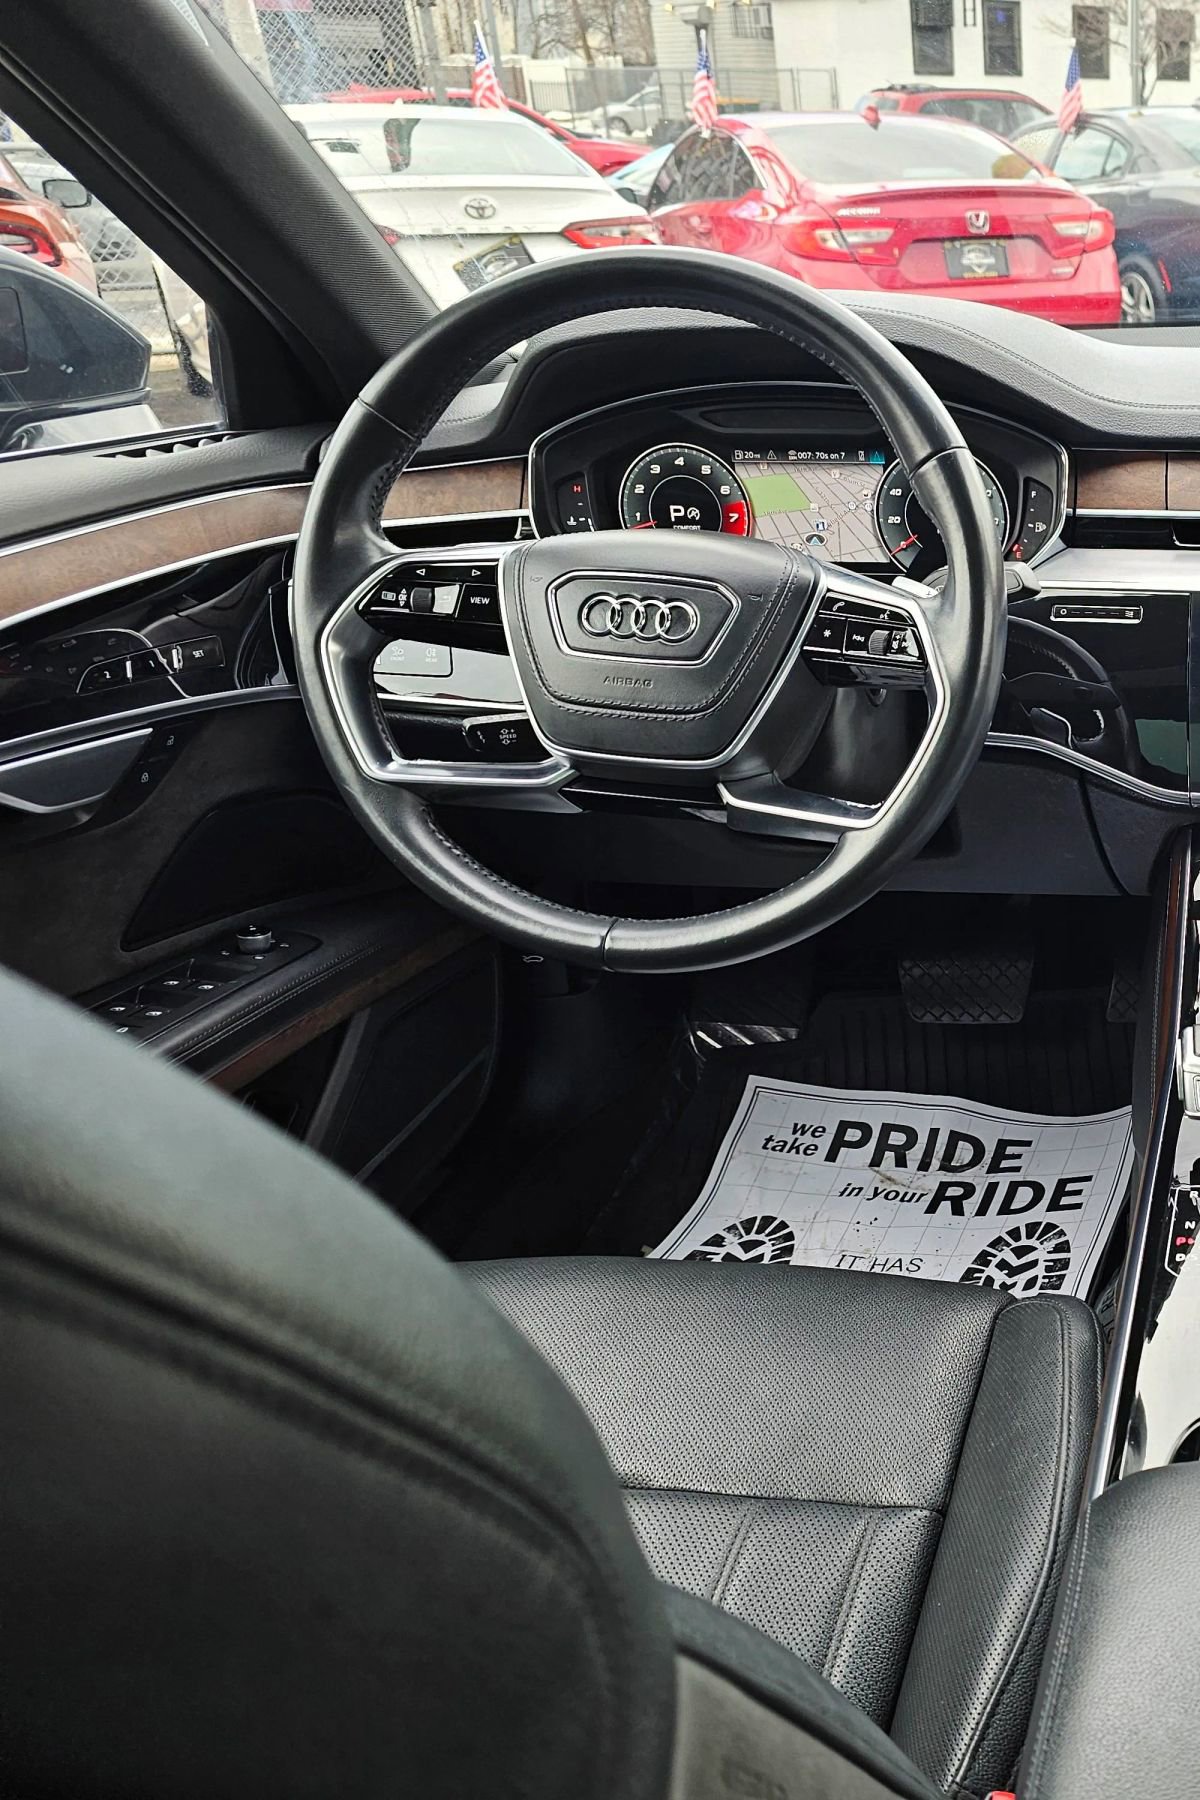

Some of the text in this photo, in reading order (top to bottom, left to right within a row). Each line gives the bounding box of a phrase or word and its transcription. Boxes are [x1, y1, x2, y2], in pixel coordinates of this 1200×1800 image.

[815, 451, 829, 459] 70s
[674, 456, 685, 466] 4
[650, 464, 661, 474] 3
[701, 464, 712, 474] 5
[573, 485, 582, 493] H
[634, 484, 645, 494] 2
[720, 485, 731, 495] 6
[890, 488, 902, 496] 40
[1031, 490, 1037, 498] F
[635, 511, 641, 522] 1
[669, 505, 685, 522] P
[729, 513, 740, 522] 7
[888, 516, 901, 524] 20
[1016, 551, 1022, 559] E
[470, 596, 490, 605] VIEW
[192, 649, 205, 658] SET
[603, 676, 654, 689] AIRBAG
[791, 1122, 826, 1139] we
[762, 1119, 1033, 1174] take PRIDE
[838, 1175, 1094, 1217] in your RIDE
[1184, 1221, 1196, 1230] N
[1176, 1237, 1186, 1246] P
[1175, 1253, 1185, 1262] D
[835, 1254, 924, 1273] IT HAS
